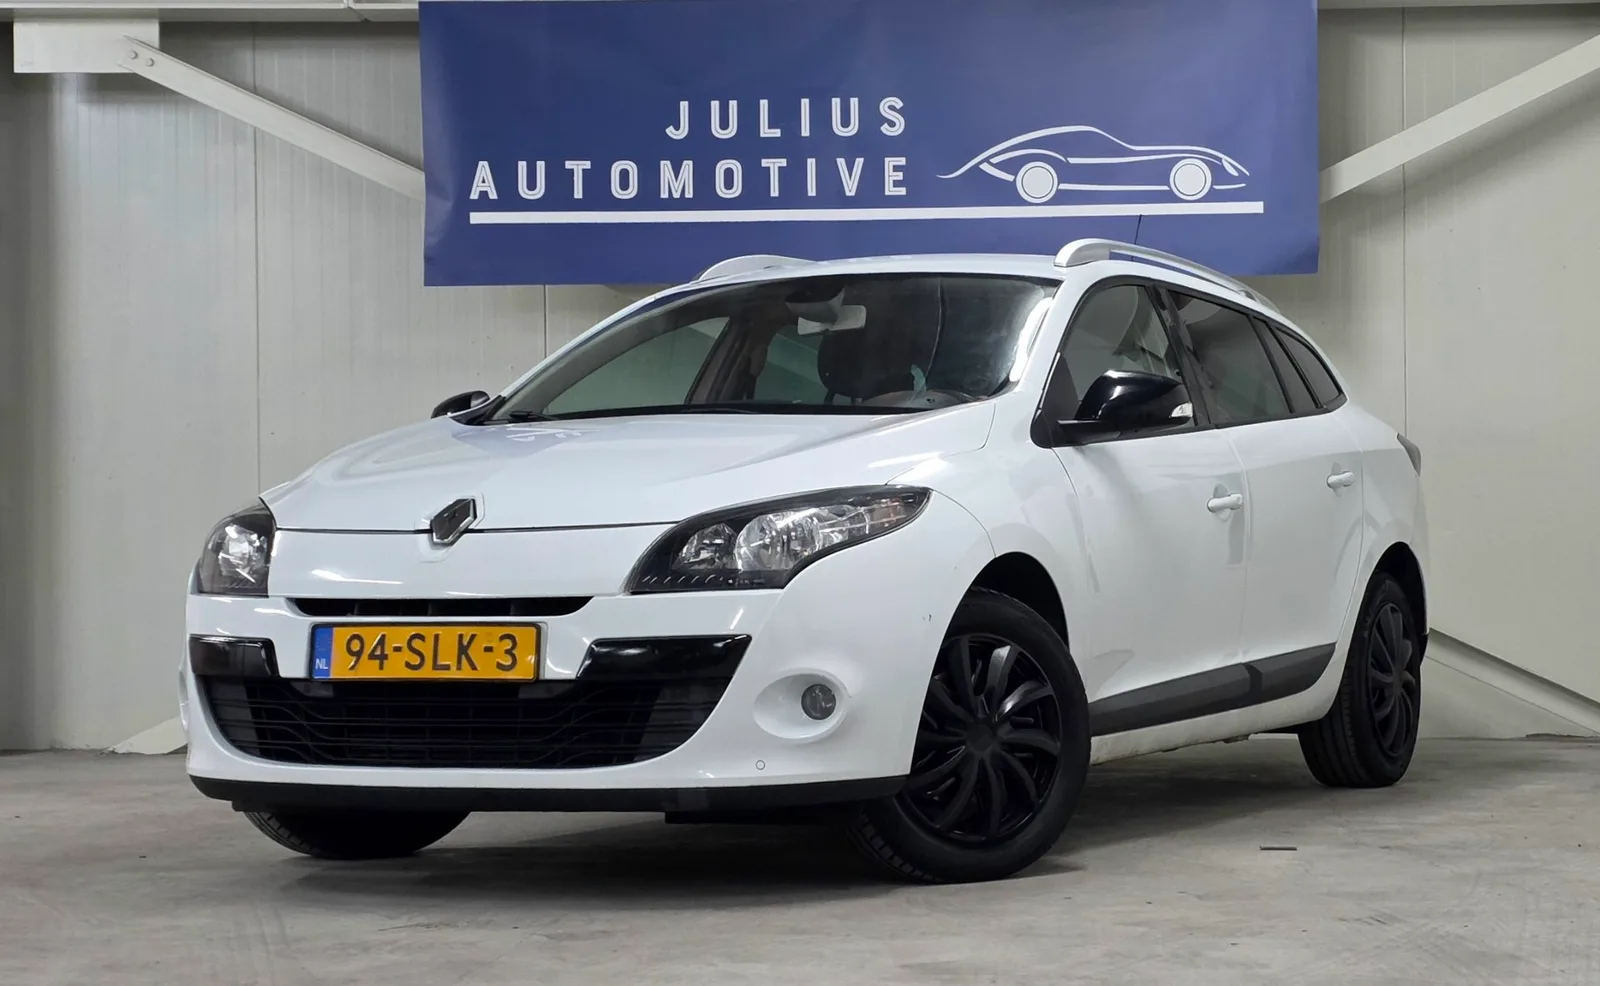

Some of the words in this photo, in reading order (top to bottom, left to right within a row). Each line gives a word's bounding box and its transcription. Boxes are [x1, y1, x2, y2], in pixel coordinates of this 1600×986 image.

[666, 97, 906, 139] JULIUS
[470, 157, 907, 199] AUTOMOTIVE
[314, 658, 329, 670] NL
[345, 633, 518, 671] 94-SLK-3
